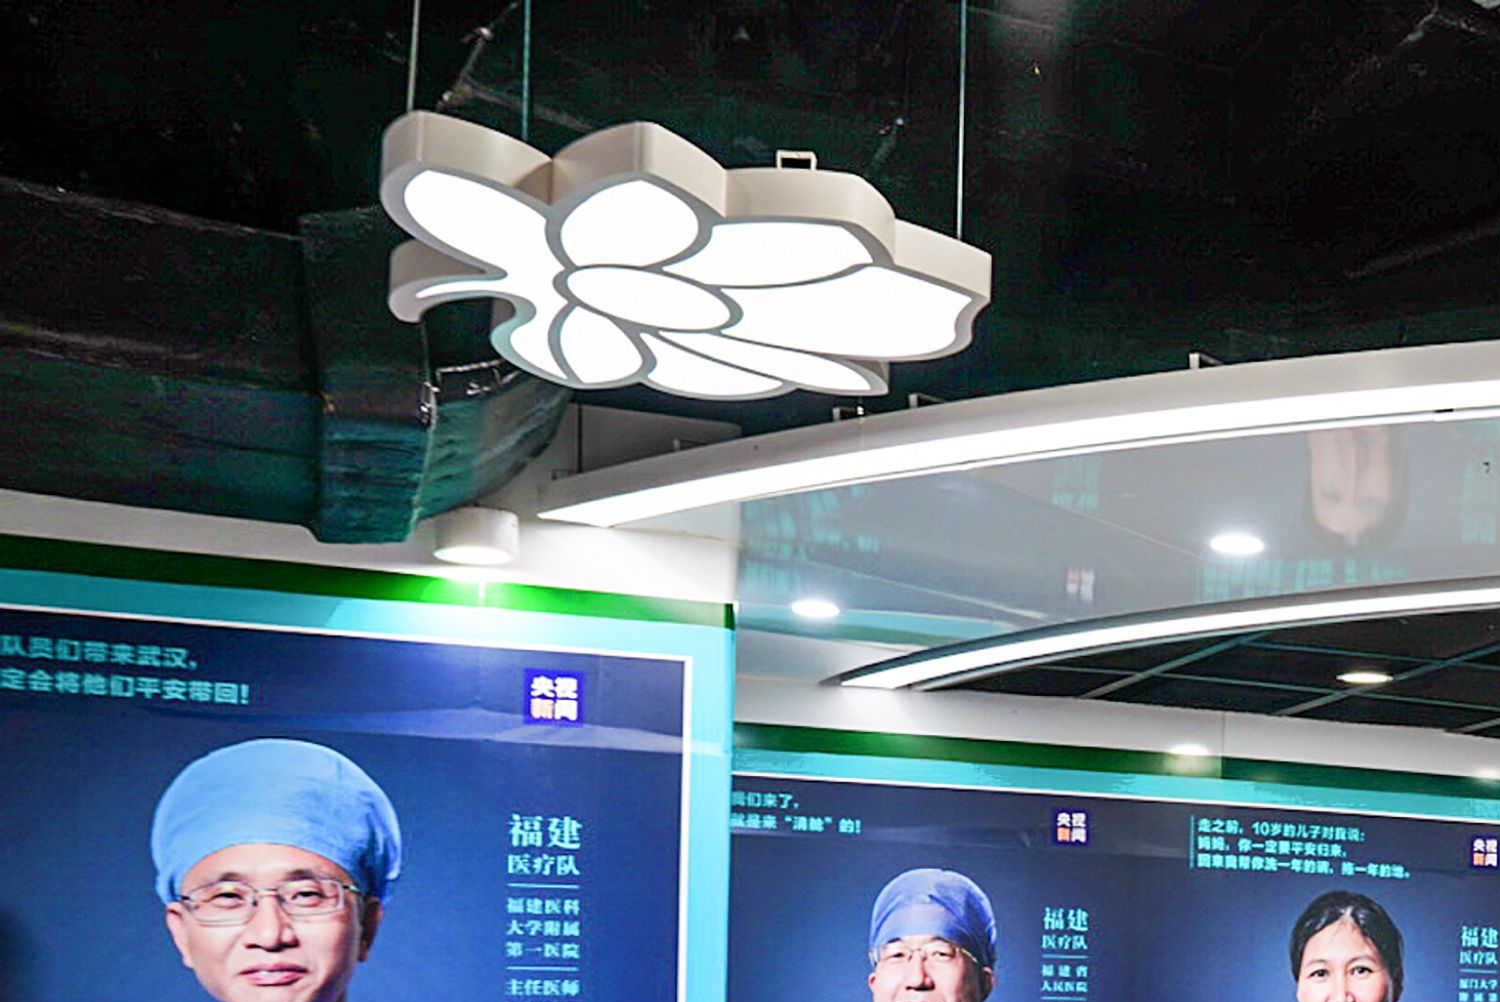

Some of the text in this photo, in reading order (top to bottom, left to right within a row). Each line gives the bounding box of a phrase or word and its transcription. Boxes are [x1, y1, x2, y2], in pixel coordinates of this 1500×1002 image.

[508, 813, 582, 850] 福建
[507, 853, 580, 876] 医疗队
[506, 897, 580, 915] 福建医科
[506, 919, 580, 937] 大学附属
[1043, 906, 1089, 932] 福建
[1042, 934, 1088, 950] 医疗队
[1461, 925, 1499, 949] 福建
[505, 941, 580, 959] 第一医院
[1460, 950, 1498, 965] 医疗队
[505, 979, 580, 996] 主任医师
